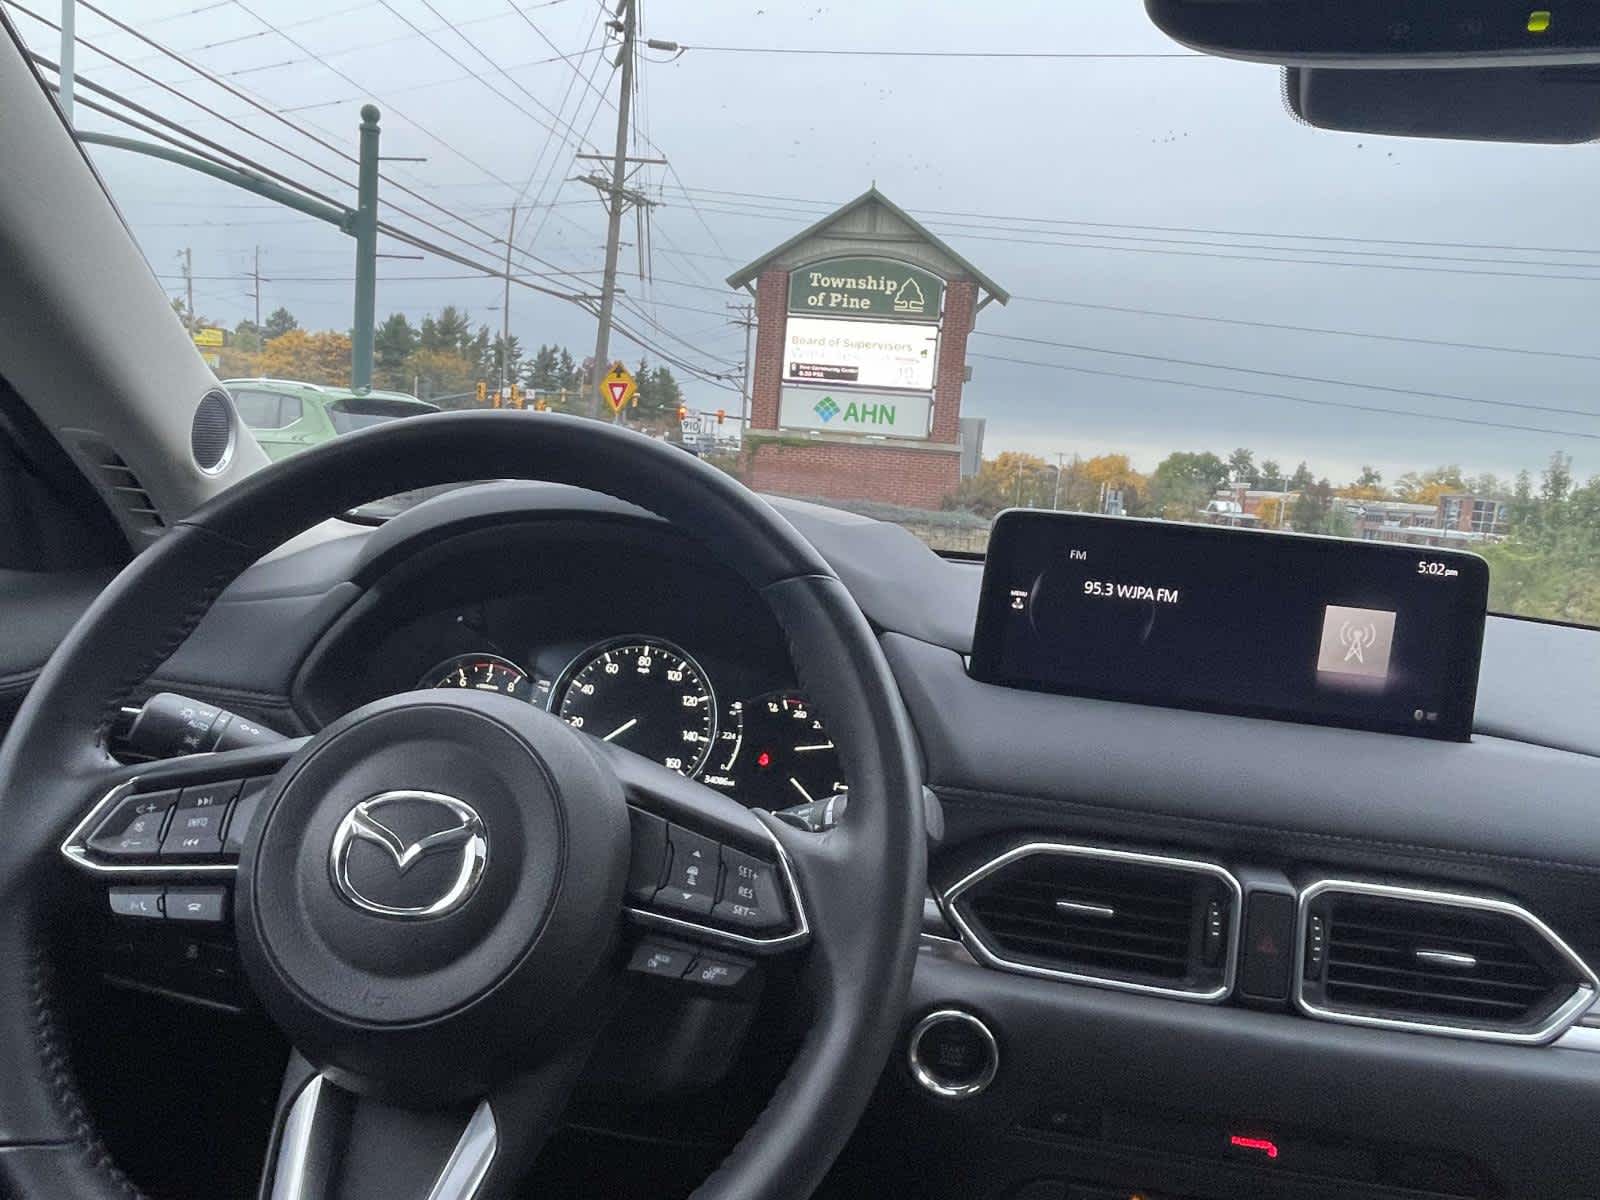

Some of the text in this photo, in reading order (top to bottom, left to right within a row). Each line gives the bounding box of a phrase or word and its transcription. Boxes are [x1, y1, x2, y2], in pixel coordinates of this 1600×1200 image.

[809, 272, 898, 294] Township
[807, 292, 871, 309] of Pine
[791, 335, 913, 352] Board of Supervisors
[843, 402, 896, 425] AHN
[683, 421, 699, 431] 910
[1069, 550, 1087, 560] FM
[1083, 581, 1179, 603] 95.3 WJPA FM
[637, 656, 651, 667] 80
[605, 663, 619, 674] 60
[459, 676, 467, 687] 6
[486, 672, 494, 683] 7
[667, 670, 683, 681] 100
[507, 681, 515, 693] 8
[580, 684, 595, 696] 40
[682, 695, 698, 707] 120
[793, 709, 807, 719] 260
[570, 716, 584, 728] 20
[682, 730, 699, 742] 140
[665, 757, 682, 769] 160
[738, 886, 753, 899] RES
